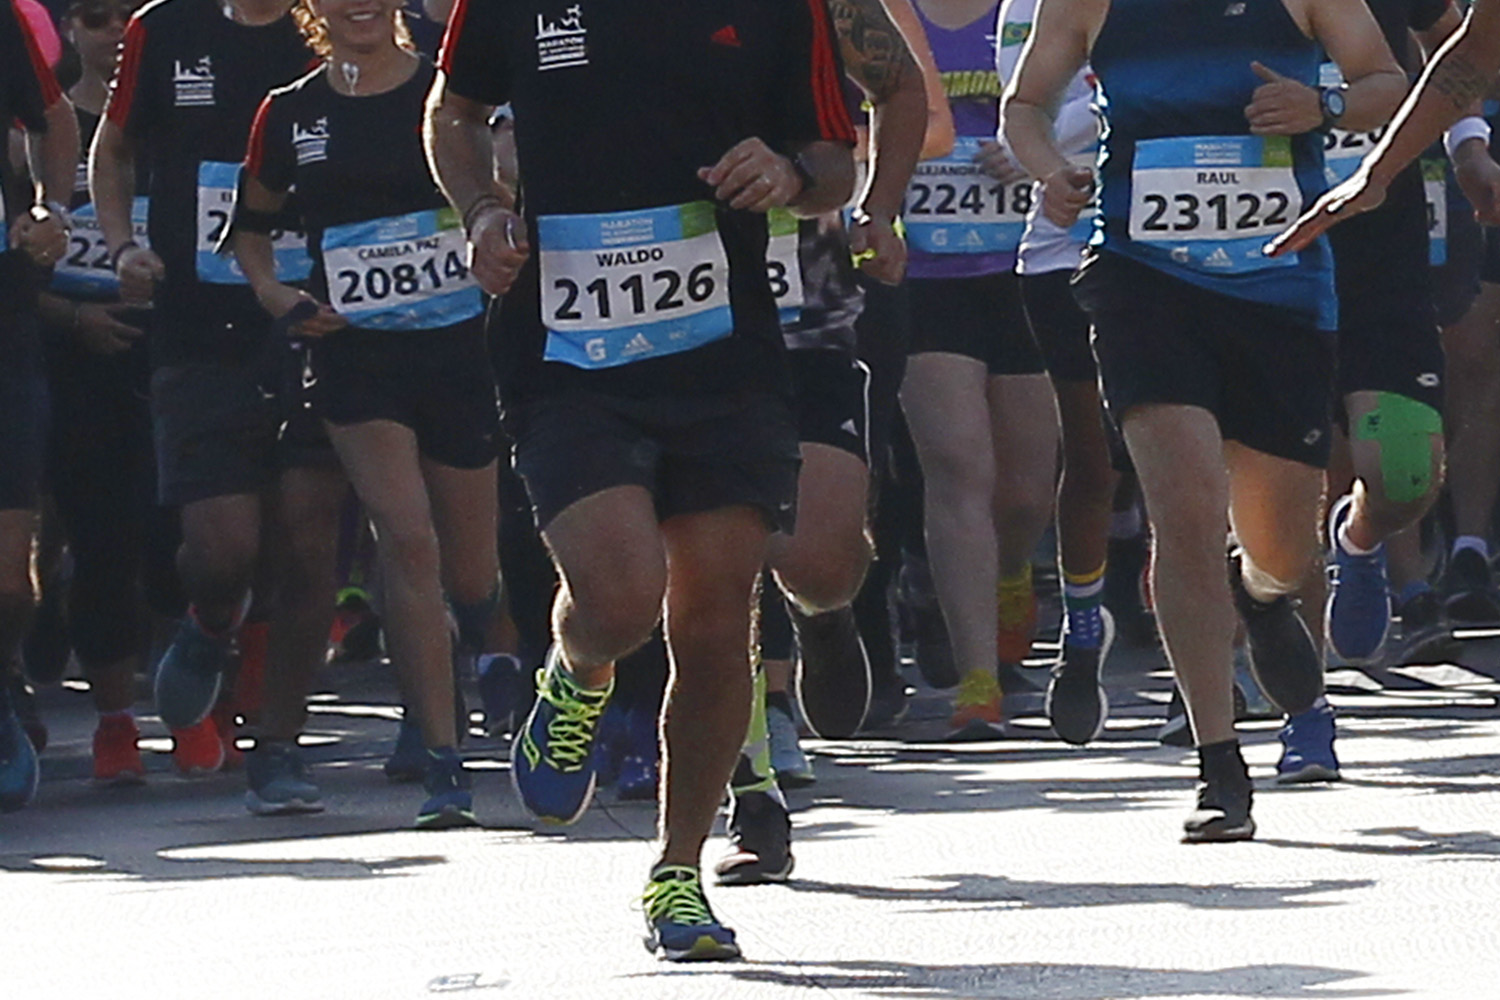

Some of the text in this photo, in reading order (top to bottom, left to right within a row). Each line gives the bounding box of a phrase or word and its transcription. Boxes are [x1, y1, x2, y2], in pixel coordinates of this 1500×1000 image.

[1196, 171, 1241, 185] RAUL
[909, 183, 1033, 215] 22418
[1142, 191, 1290, 232] 23122
[359, 237, 441, 260] CAMILA PAZ
[595, 247, 665, 268] WALDO
[338, 250, 469, 304] 20814
[553, 261, 717, 321] 21126
